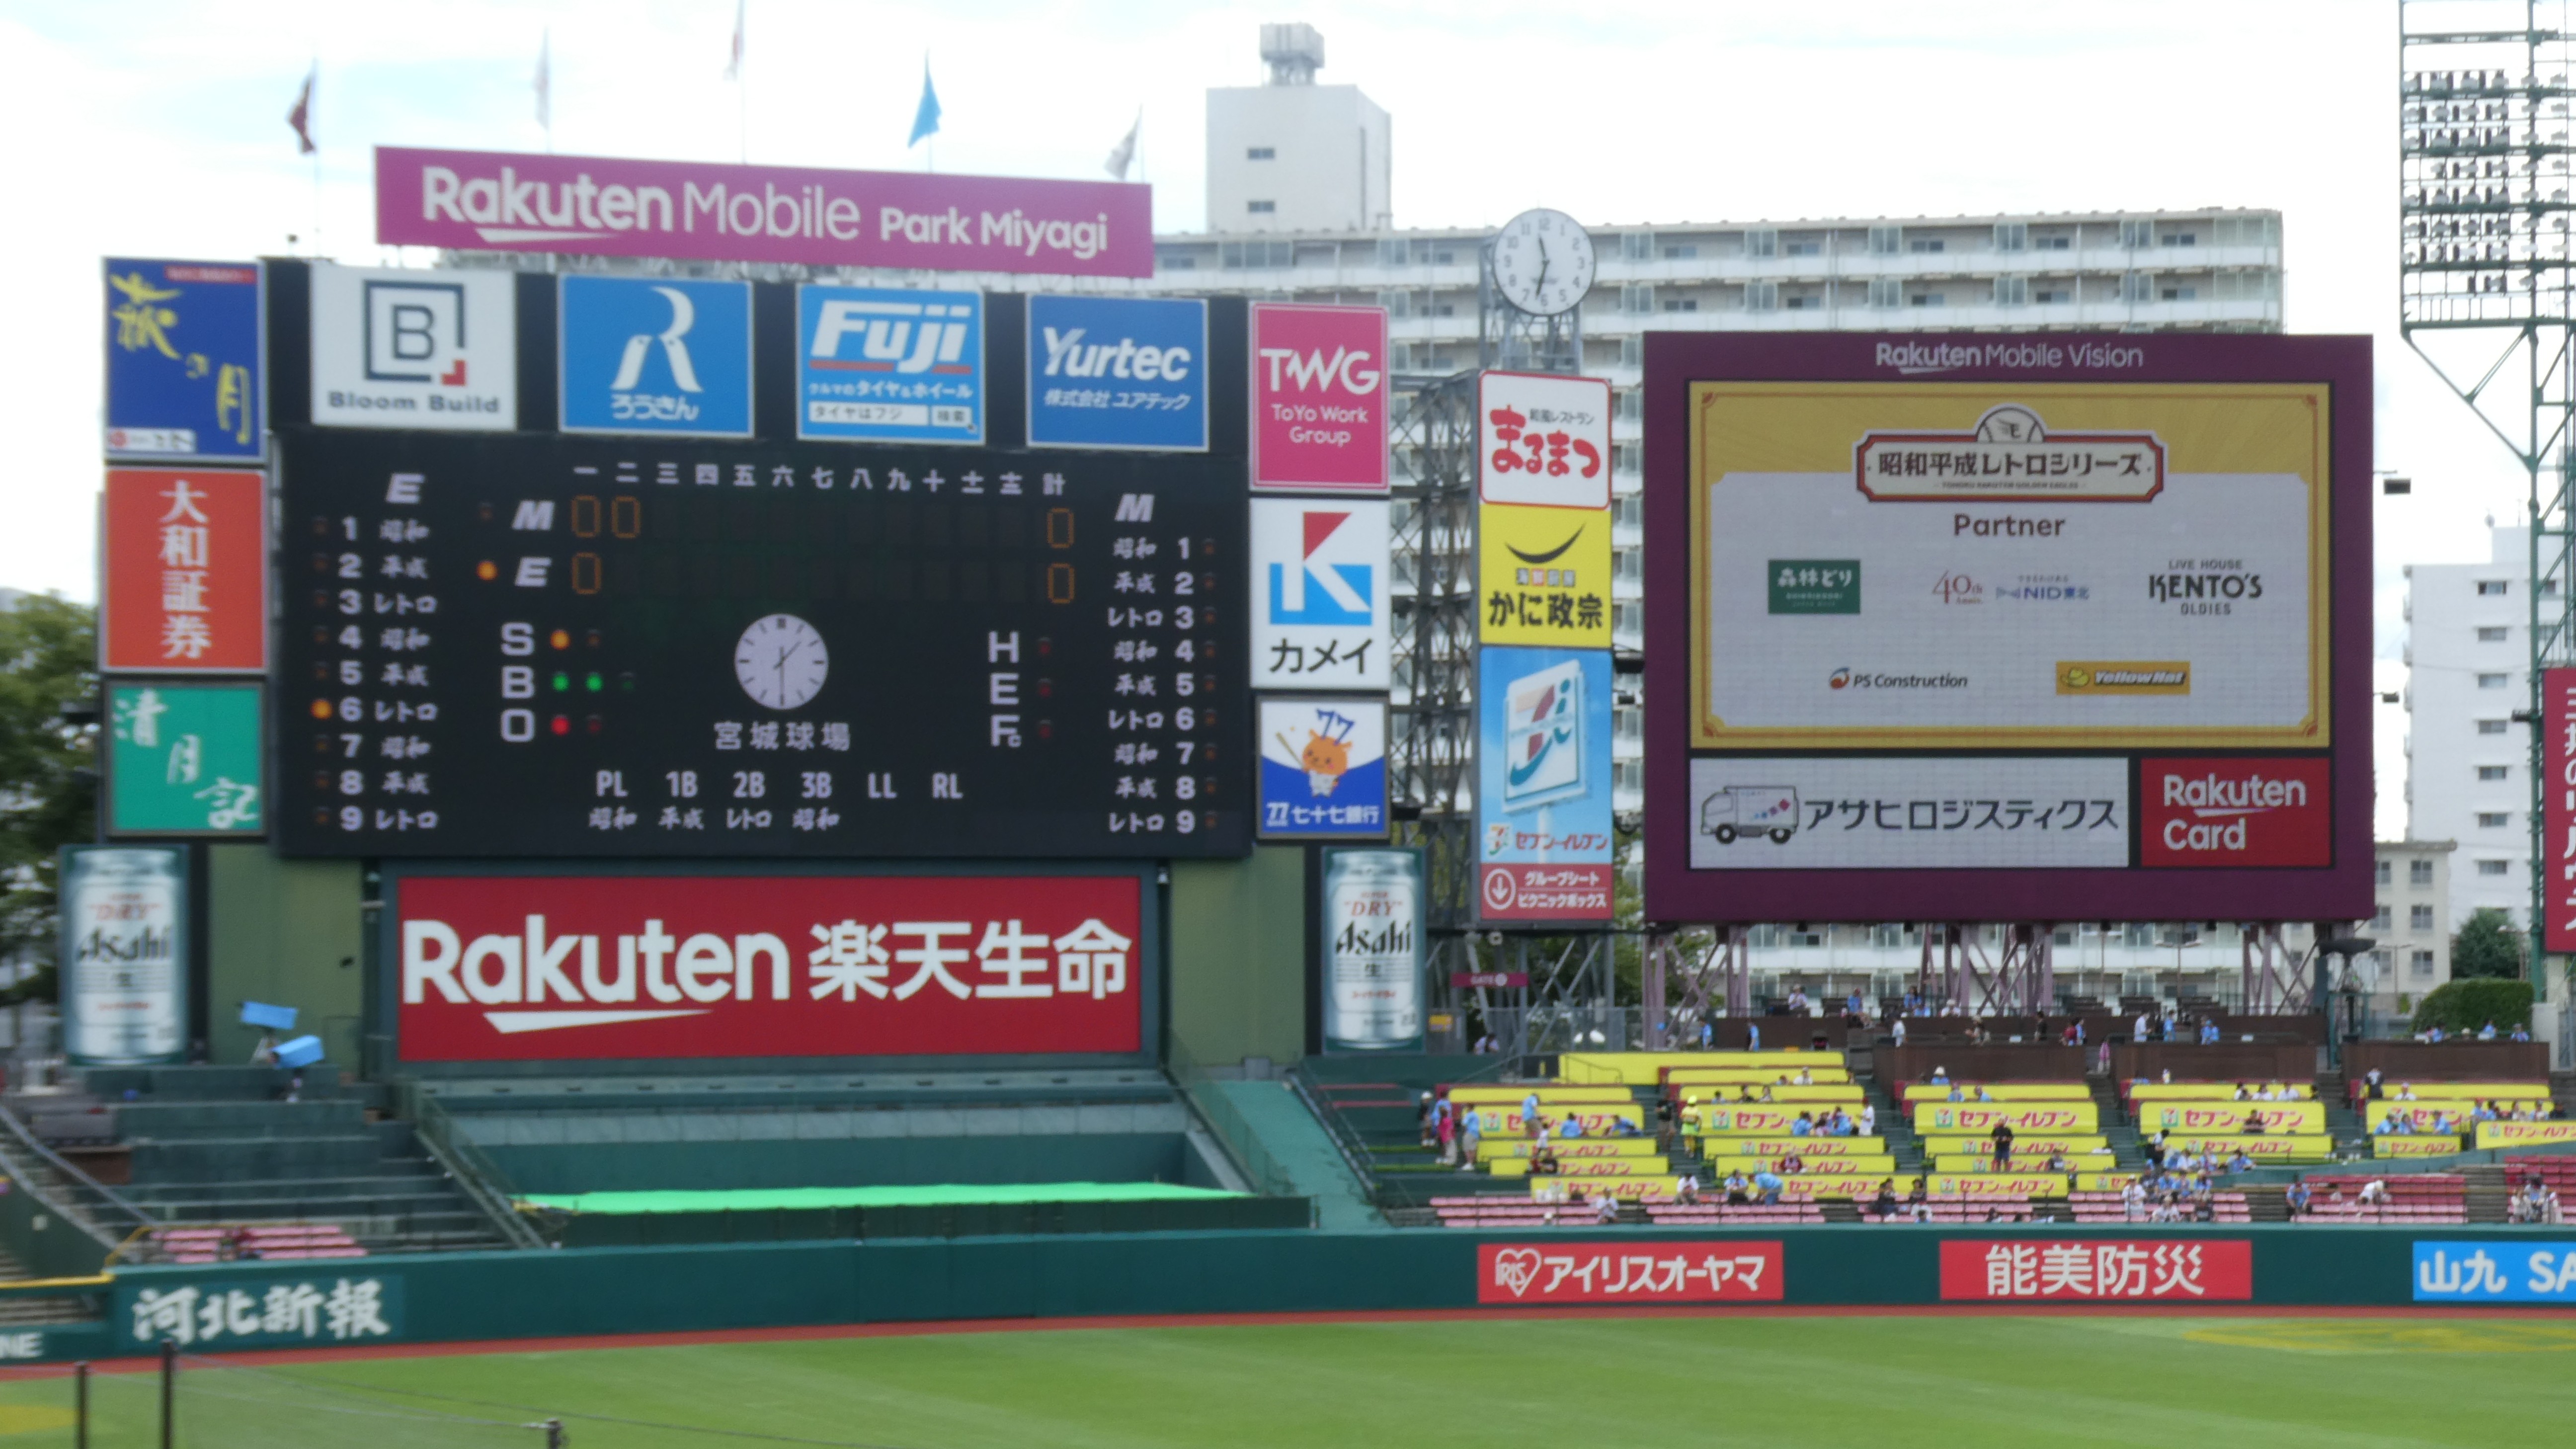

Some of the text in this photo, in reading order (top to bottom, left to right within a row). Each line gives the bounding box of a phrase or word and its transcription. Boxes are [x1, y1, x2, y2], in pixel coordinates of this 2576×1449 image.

[422, 165, 1108, 259] Rakuten Mobile Park Miyagi
[810, 300, 972, 374] Fuji
[1044, 326, 1191, 382] Yurtec
[1876, 343, 2144, 368] Rakuten Mobile Vision
[1259, 346, 1380, 395] TWG
[328, 392, 500, 413] Bloom Build
[610, 394, 700, 421] ろうきん
[815, 405, 902, 420] タイヤはフジ
[1045, 389, 1192, 410] 株式会社 ユアテック
[1320, 405, 1368, 423] Work
[1289, 426, 1352, 447] Group
[1490, 405, 1601, 479] まるまつ
[1878, 452, 2141, 476] 昭和平成レトロシリーズ
[386, 473, 424, 504] E
[616, 462, 639, 483] 二
[656, 462, 679, 484] 三
[695, 464, 719, 485] 四
[733, 464, 756, 486] 五
[772, 465, 794, 487] 六
[811, 467, 833, 489] 七
[850, 468, 873, 489] 八
[887, 468, 911, 491] 九
[922, 469, 945, 492] 十
[1043, 473, 1065, 495] 計
[1115, 493, 1154, 522] M
[343, 516, 357, 541] 1
[512, 494, 1074, 549] M 0 0 0
[1954, 514, 2066, 536] Partner
[1178, 537, 1189, 560] 1
[159, 480, 212, 659] 大和証券
[339, 553, 362, 578] 2
[515, 552, 1075, 604] E 0 0
[2168, 560, 2243, 570] LIVE HOUSE
[1175, 571, 1194, 595] 2
[2149, 573, 2262, 603] KENTO'S
[339, 589, 437, 615] 3 レトロ
[1489, 590, 1603, 629] かに政宗
[1108, 605, 1194, 630] レトロ 3
[339, 625, 362, 649] 4
[501, 622, 534, 656] S
[988, 631, 1019, 663] H
[1175, 640, 1195, 662] 4
[1270, 639, 1372, 674] カメイ
[340, 660, 362, 685] 5
[502, 665, 535, 699] B
[1176, 672, 1194, 696] 5
[1853, 673, 1968, 688] PS Construction
[990, 672, 1019, 705] E
[339, 696, 438, 722] 6 レトロ
[1109, 707, 1195, 730] レトロ 6
[340, 733, 362, 758] 7
[714, 721, 850, 751] 宮城球場
[113, 689, 259, 829] 清月記
[1176, 741, 1195, 765] 7
[340, 770, 363, 795] 8
[596, 770, 963, 799] PL 1B 2B 3B LL RL
[1176, 776, 1196, 800] 8
[2164, 773, 2307, 807] Rakuten
[340, 805, 438, 831] 9 レトロ
[726, 808, 772, 829] レトロ
[1109, 809, 1195, 834] レトロ 9
[1292, 805, 1380, 824] 七十七銀行
[1805, 799, 2119, 830] アサヒロジスティクス
[2163, 817, 2247, 850] Card
[1525, 871, 1600, 886] グループシート
[76, 927, 170, 962] Asahi
[1336, 920, 1411, 955] Asahi
[403, 913, 1131, 1004] Rakuten 楽天生命
[1543, 1255, 1765, 1293] アイリスオーヤマ
[1986, 1244, 2205, 1296] 能美防災
[2420, 1250, 2508, 1293] 山九
[132, 1279, 391, 1345] 河北新報
